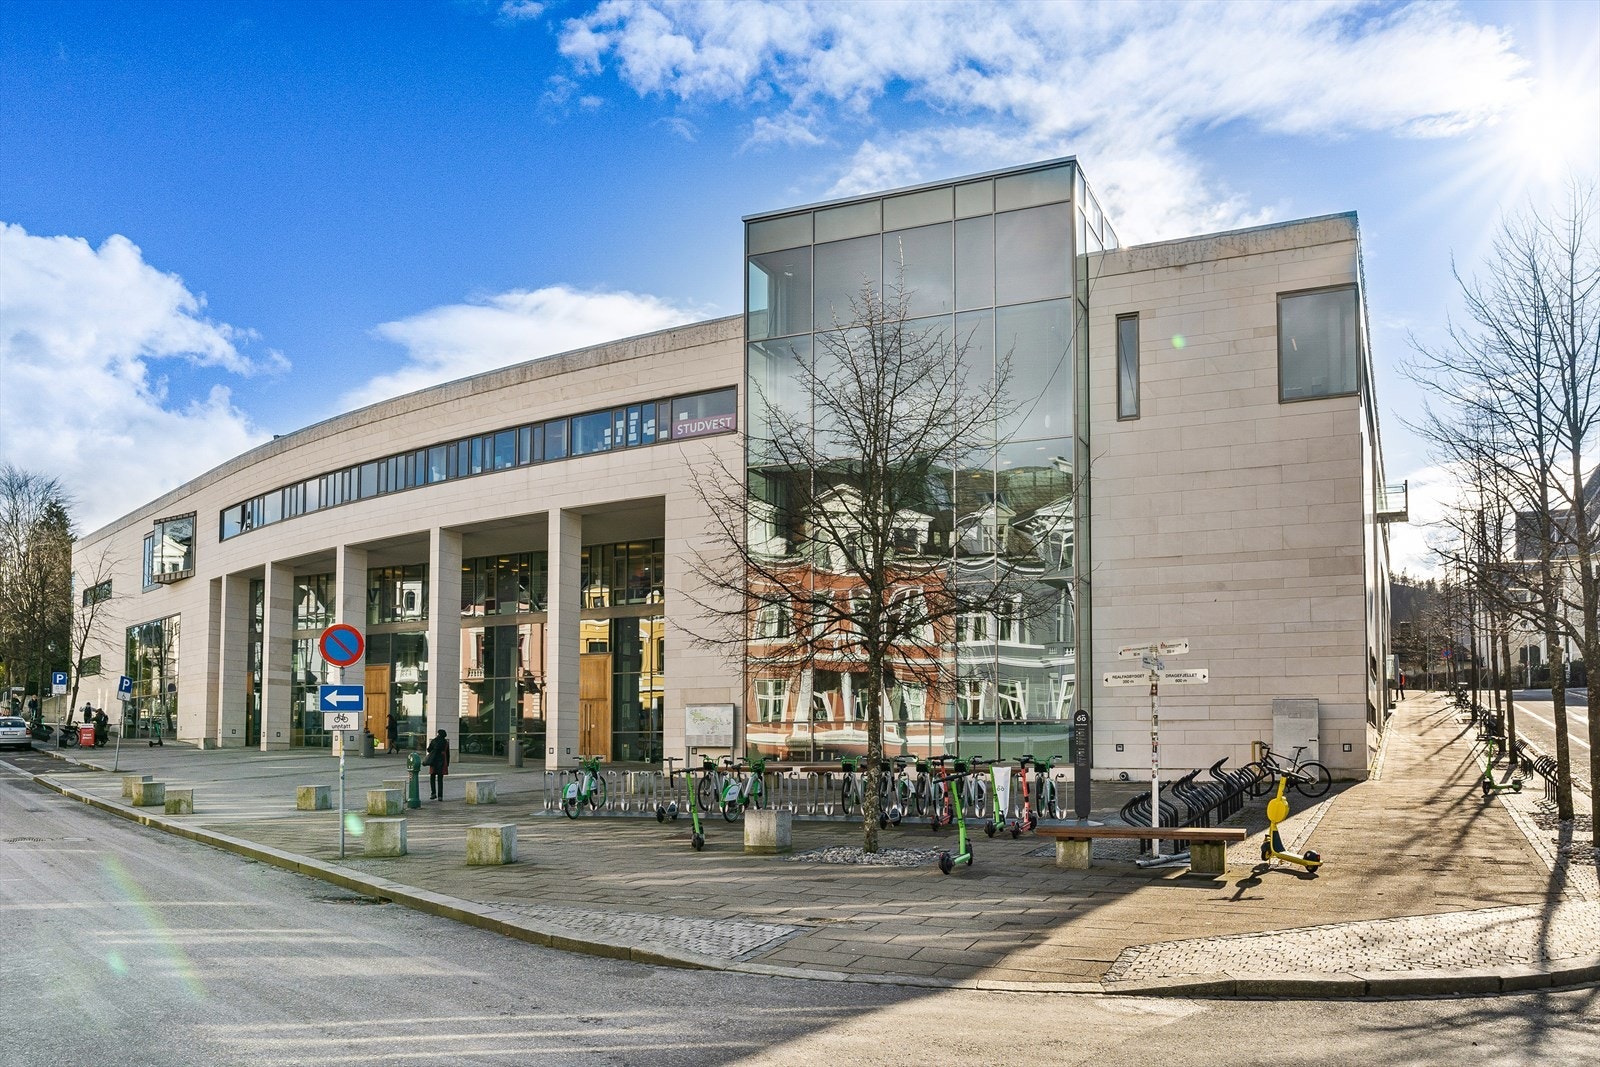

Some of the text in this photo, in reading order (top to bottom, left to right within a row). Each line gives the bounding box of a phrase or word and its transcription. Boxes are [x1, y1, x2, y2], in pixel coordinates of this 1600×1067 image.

[677, 417, 732, 435] STUDVEST
[56, 674, 64, 683] P
[122, 679, 131, 691] P
